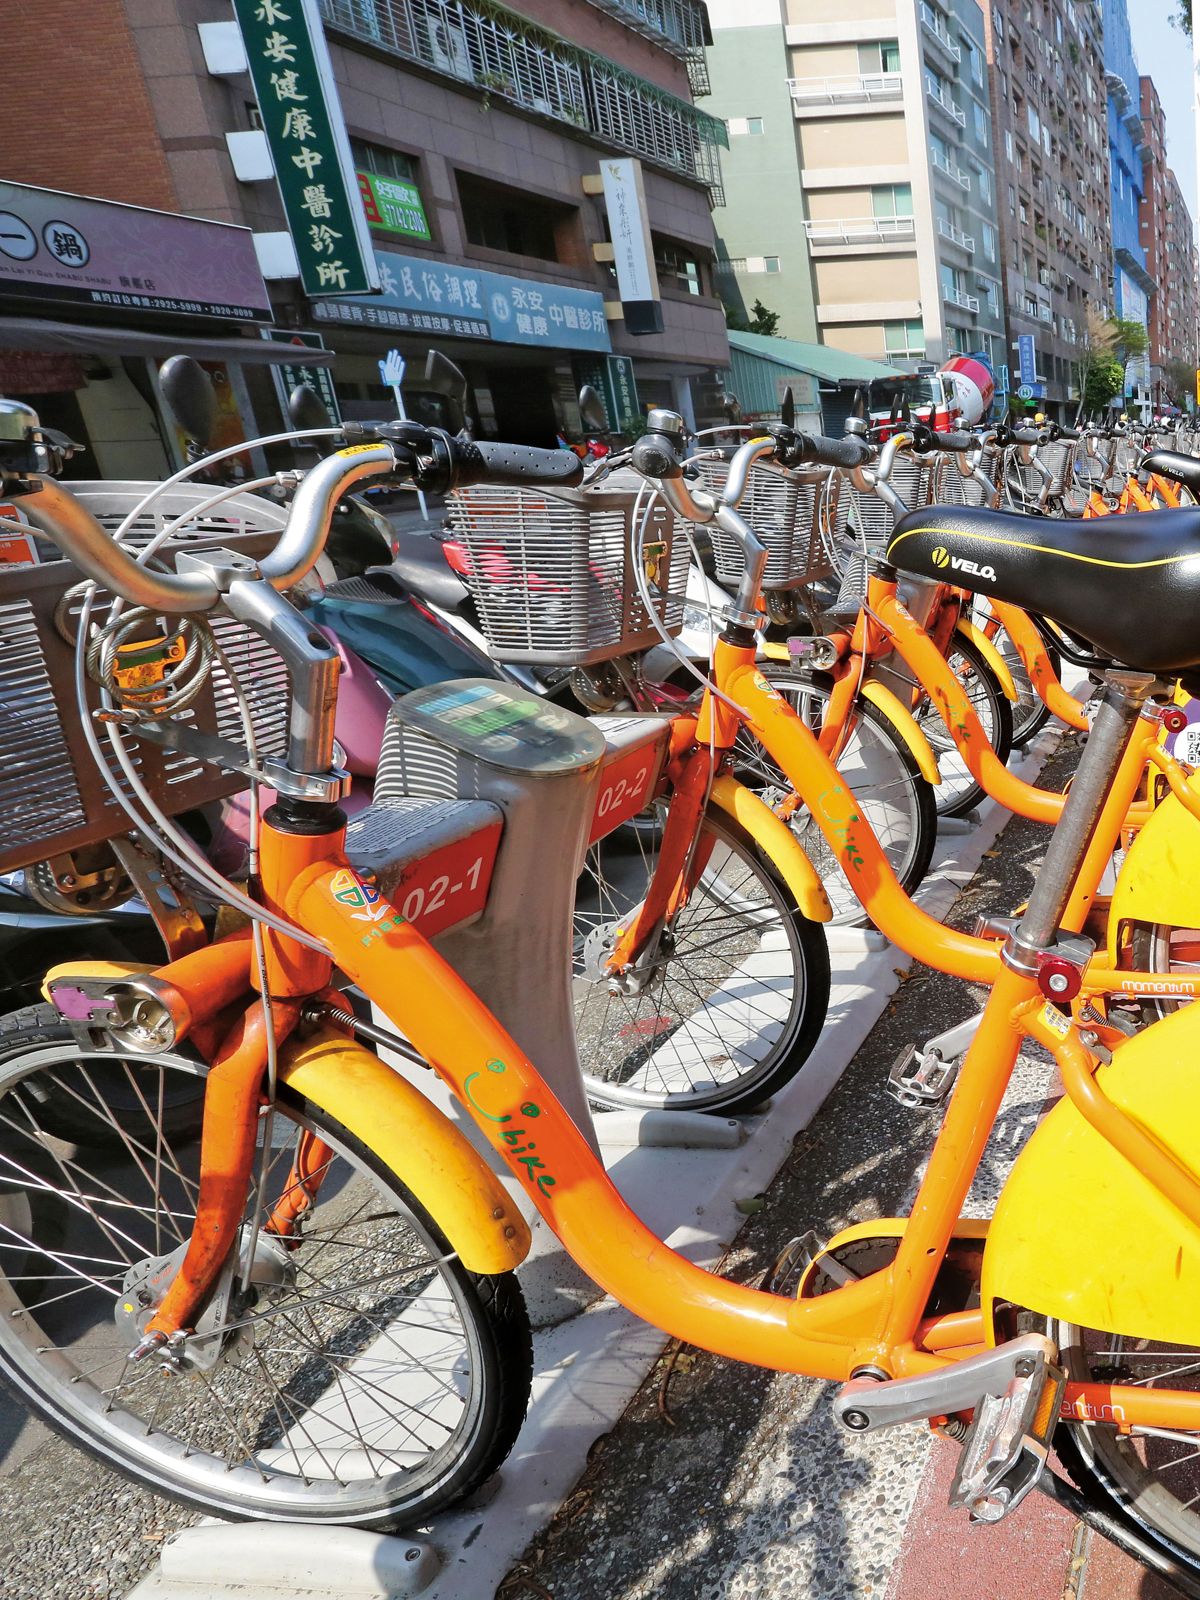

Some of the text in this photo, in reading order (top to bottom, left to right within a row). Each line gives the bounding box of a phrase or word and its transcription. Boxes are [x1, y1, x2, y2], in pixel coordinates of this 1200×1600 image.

[254, 0, 350, 290] 永安健康中醫診所
[511, 286, 545, 313] 永安
[516, 312, 549, 337] 健康
[548, 303, 606, 334] 中醫診所
[1168, 467, 1184, 477] VELO
[951, 556, 995, 579] VELO
[597, 767, 647, 817] 02-2
[402, 856, 484, 924] 02-1
[1121, 980, 1195, 993] momentum
[1060, 1400, 1126, 1421] entum
